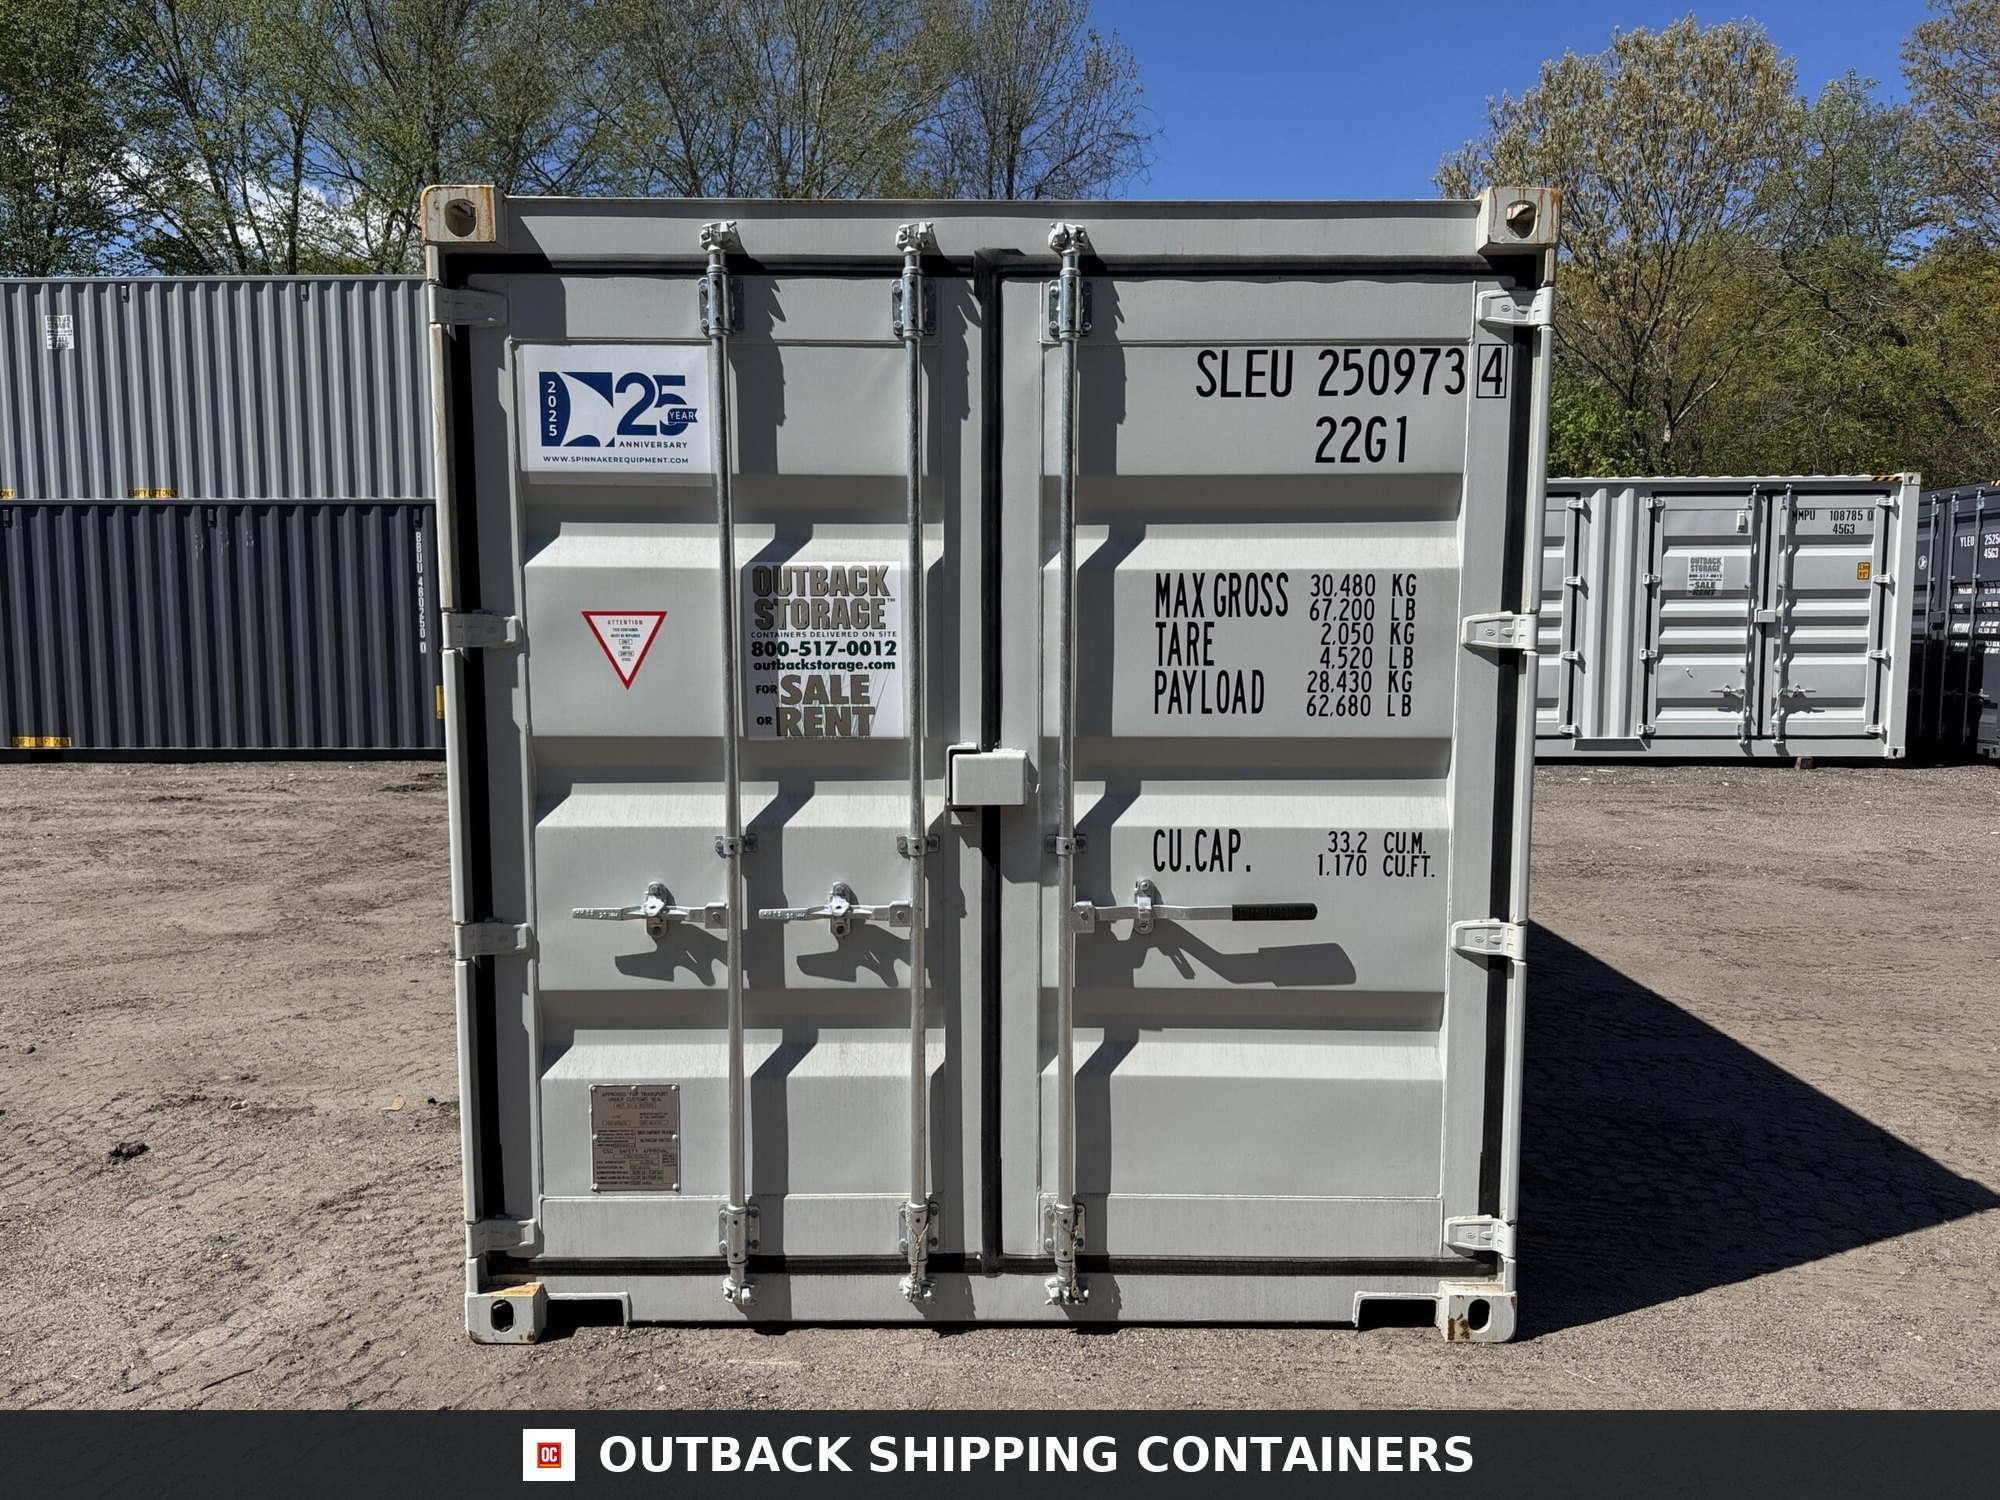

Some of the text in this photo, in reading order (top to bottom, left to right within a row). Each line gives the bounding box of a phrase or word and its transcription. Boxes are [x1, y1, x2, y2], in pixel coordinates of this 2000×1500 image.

[1196, 347, 1503, 397] SLEU 250973 4
[547, 381, 558, 437] 2025
[669, 410, 695, 421] YEAR
[619, 441, 688, 449] ANNIVERSARY
[1315, 415, 1407, 463] 22G1
[543, 455, 689, 464] WWW.SPINNAKEREQUIPMENT.COM
[1829, 510, 1863, 521] 108785
[1833, 523, 1855, 534] 45G3
[1984, 534, 2000, 546] 2525
[752, 565, 890, 597] OUTBACK
[1310, 573, 1417, 597] 30,480 KG
[1155, 572, 1289, 618] MAX GROSS
[754, 598, 886, 630] STORAGE
[1309, 598, 1416, 622] 67,200 LB
[1155, 621, 1215, 667] TARE
[1320, 622, 1415, 646] 2,050 KG
[751, 640, 897, 657] 800-517-0012
[1320, 646, 1414, 670] 4,520 LB
[753, 659, 896, 672] outbackstorage.com
[756, 674, 870, 705] FOR SALE
[1154, 669, 1264, 714] PAYLOAD
[1307, 670, 1413, 694] 28,430 KG
[1306, 694, 1412, 717] 62,680 LB
[756, 706, 875, 737] OR RENT
[1153, 829, 1251, 872] CU.CAP.
[1328, 831, 1427, 854] 33.2 CU.M.
[1318, 854, 1435, 877] 1,170 CU.FT.
